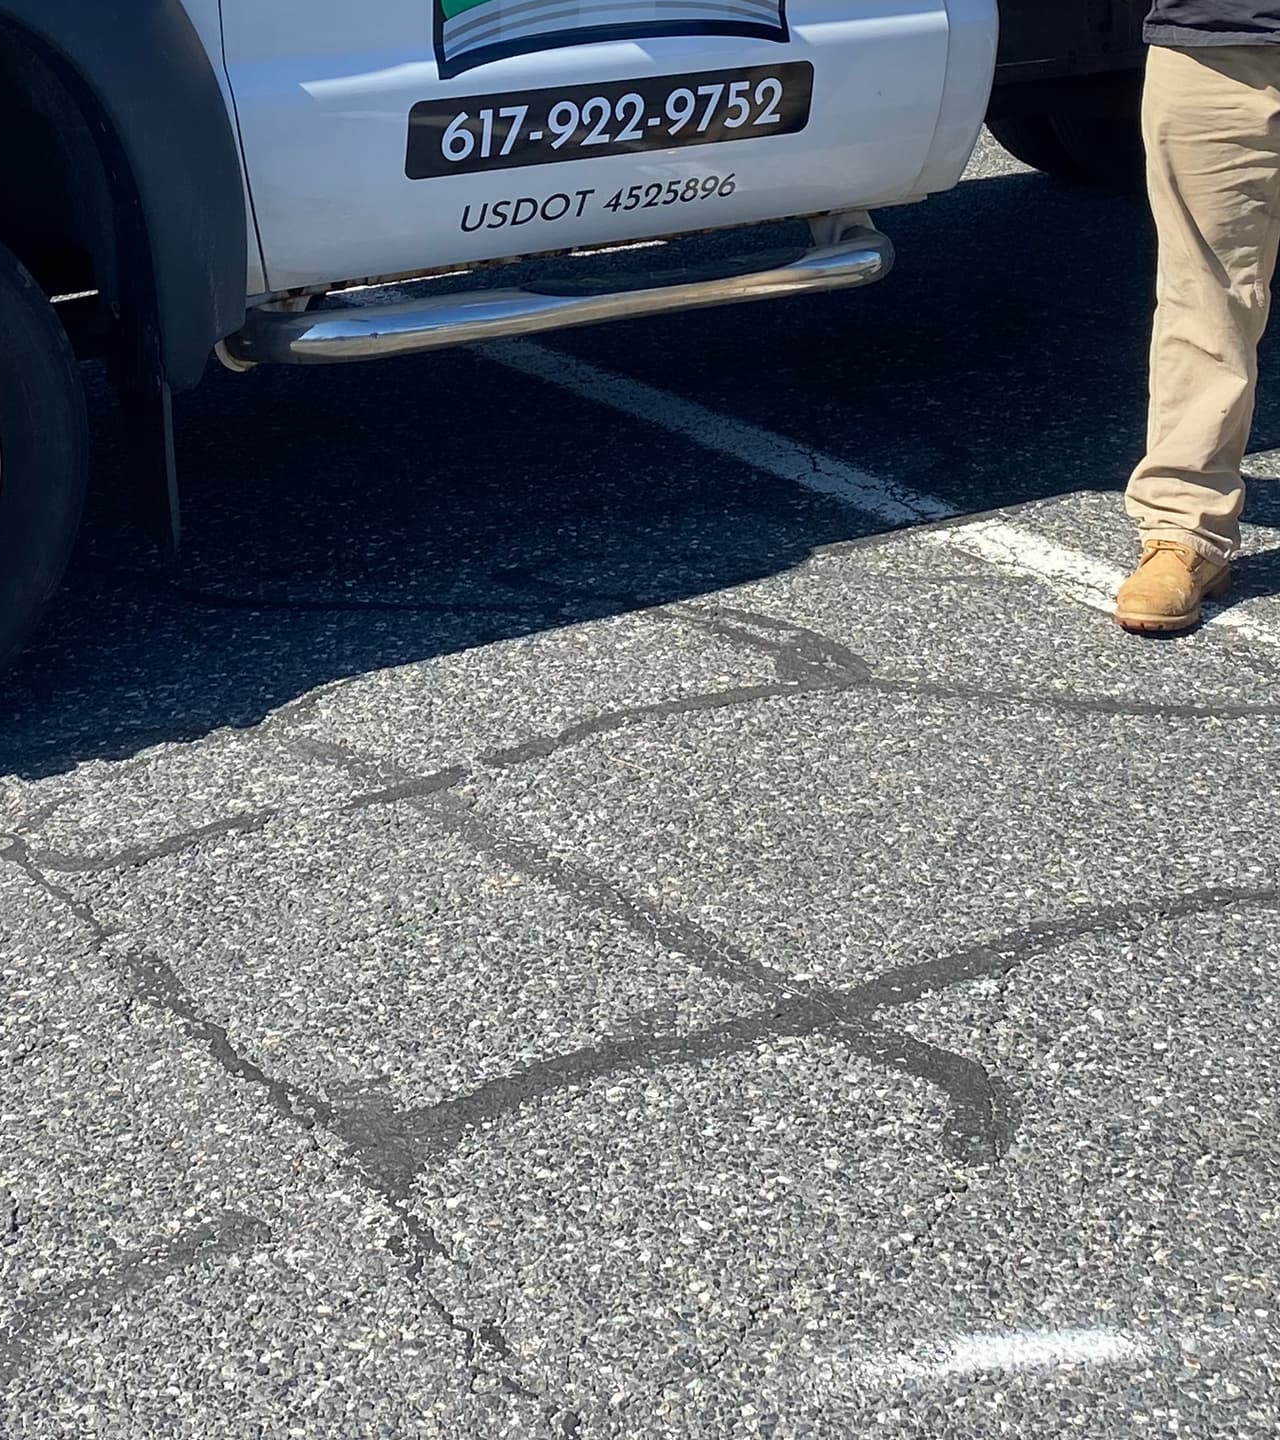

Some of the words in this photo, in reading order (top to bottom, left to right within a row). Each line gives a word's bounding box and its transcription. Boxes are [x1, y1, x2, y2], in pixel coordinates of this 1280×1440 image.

[440, 77, 784, 162] 617-922-9752
[460, 189, 596, 232] USDOT
[603, 172, 737, 213] 4525896
